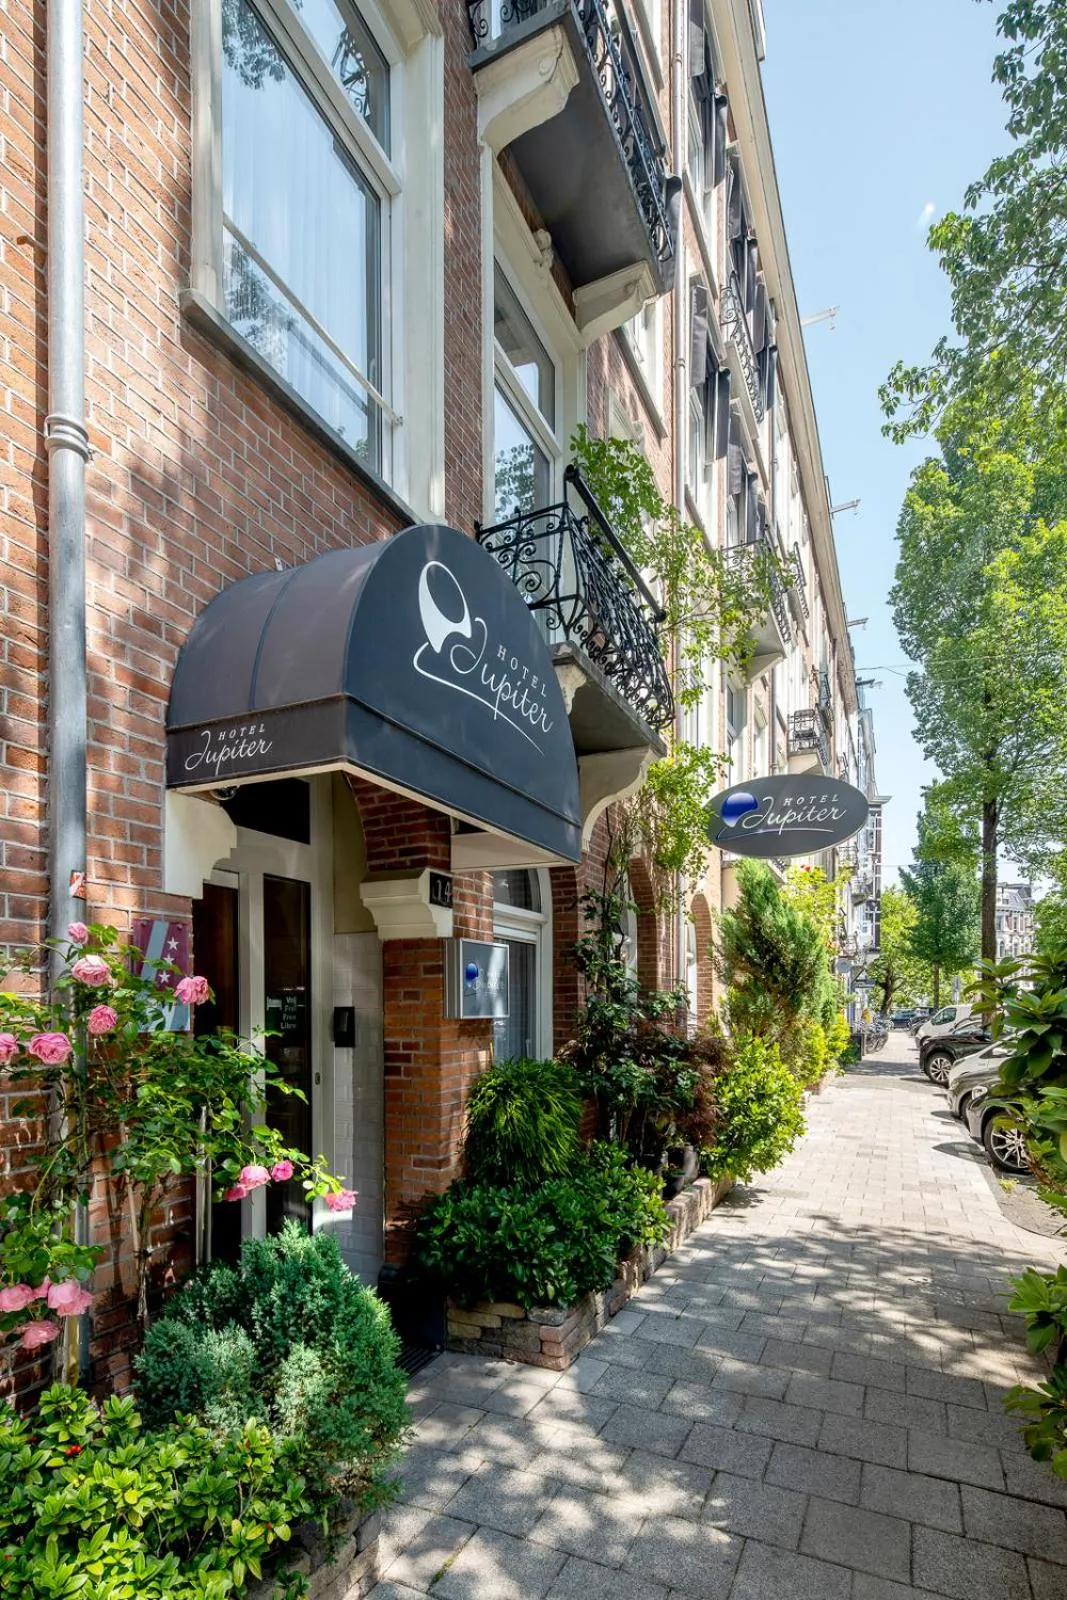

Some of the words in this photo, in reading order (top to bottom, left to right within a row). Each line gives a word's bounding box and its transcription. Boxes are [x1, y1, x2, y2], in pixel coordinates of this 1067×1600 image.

[450, 617, 554, 733] Jupiter
[496, 644, 547, 698] HOTEL
[184, 730, 273, 776] Jupiter
[218, 723, 265, 741] HOTEL
[741, 796, 847, 836] Jupiter
[783, 794, 839, 806] HOTEL
